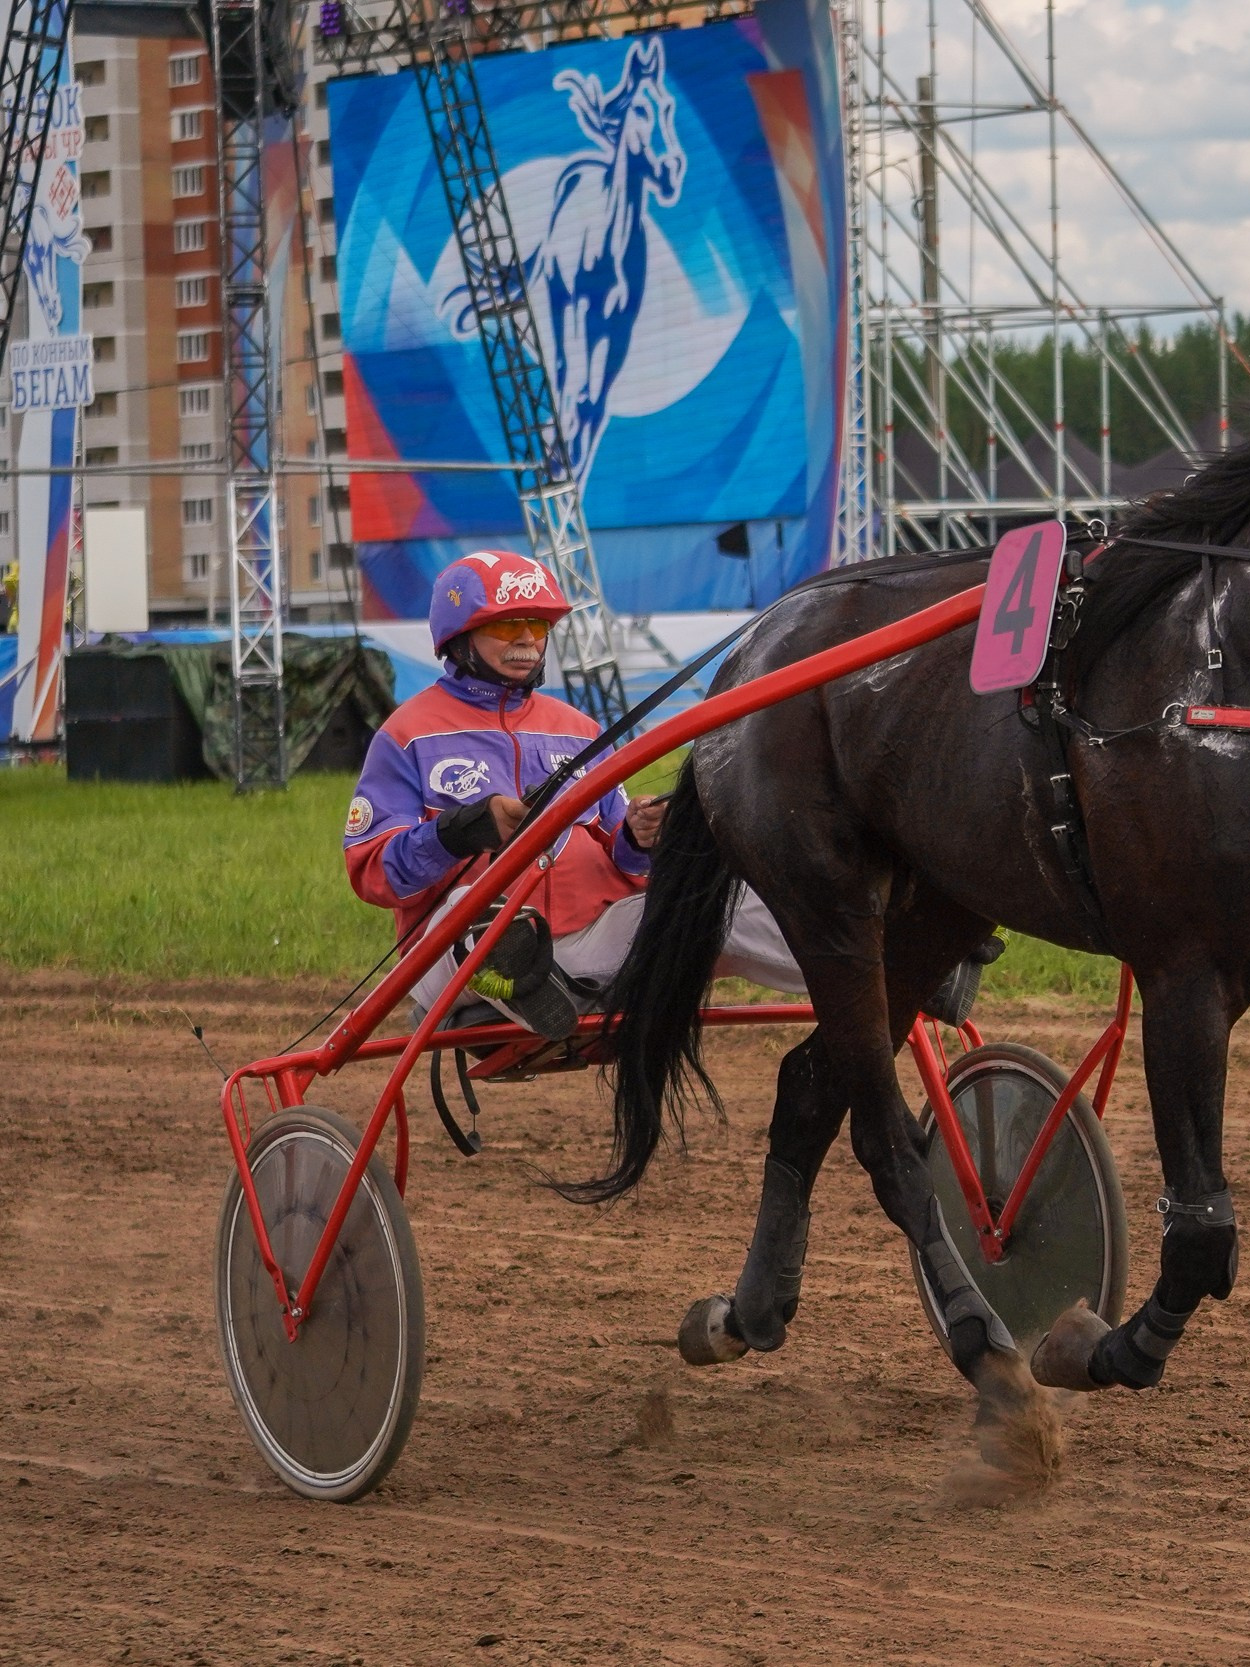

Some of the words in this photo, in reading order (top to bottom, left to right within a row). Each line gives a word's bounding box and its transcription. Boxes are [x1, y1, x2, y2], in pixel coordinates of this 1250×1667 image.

[5, 87, 80, 134] БОК
[13, 346, 29, 367] ПО
[32, 339, 89, 364] КОННЫМ
[13, 364, 90, 408] БЕГАМ
[992, 530, 1043, 655] 4
